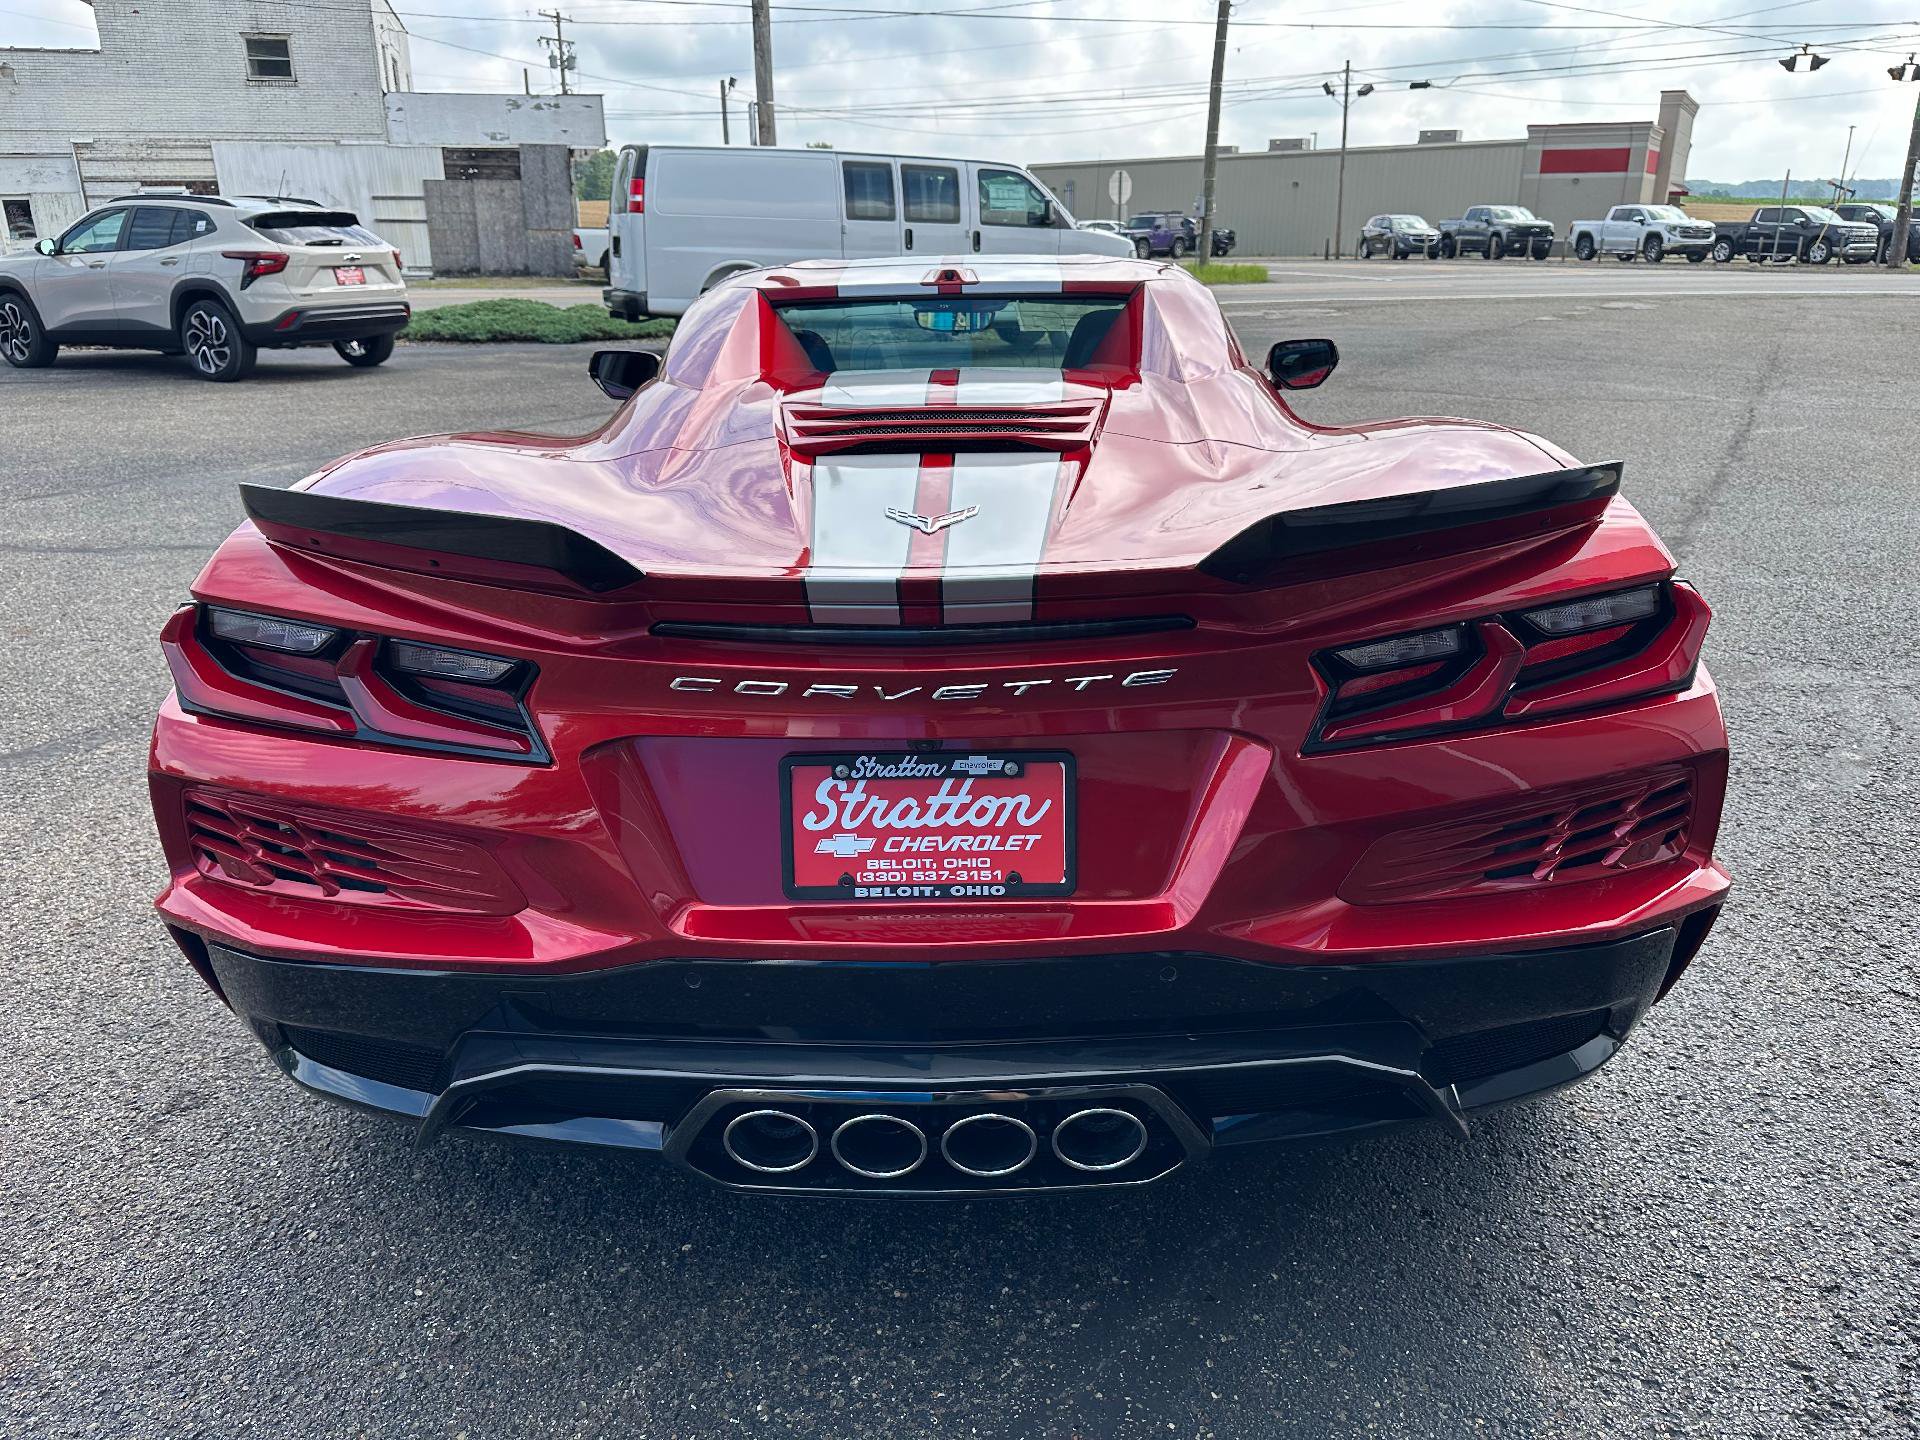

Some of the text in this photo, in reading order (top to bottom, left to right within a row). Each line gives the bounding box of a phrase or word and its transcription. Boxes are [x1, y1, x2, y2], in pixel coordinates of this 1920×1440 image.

[669, 667, 1179, 701] CORVETTE
[851, 755, 947, 779] Stratton
[802, 777, 1052, 831] Stratton
[883, 834, 1042, 853] CHEVROLET
[866, 858, 991, 870] BELOIT, OHIO
[856, 870, 1002, 883] (330) 537-3151
[854, 885, 1006, 898] BELOIT, OHIO
